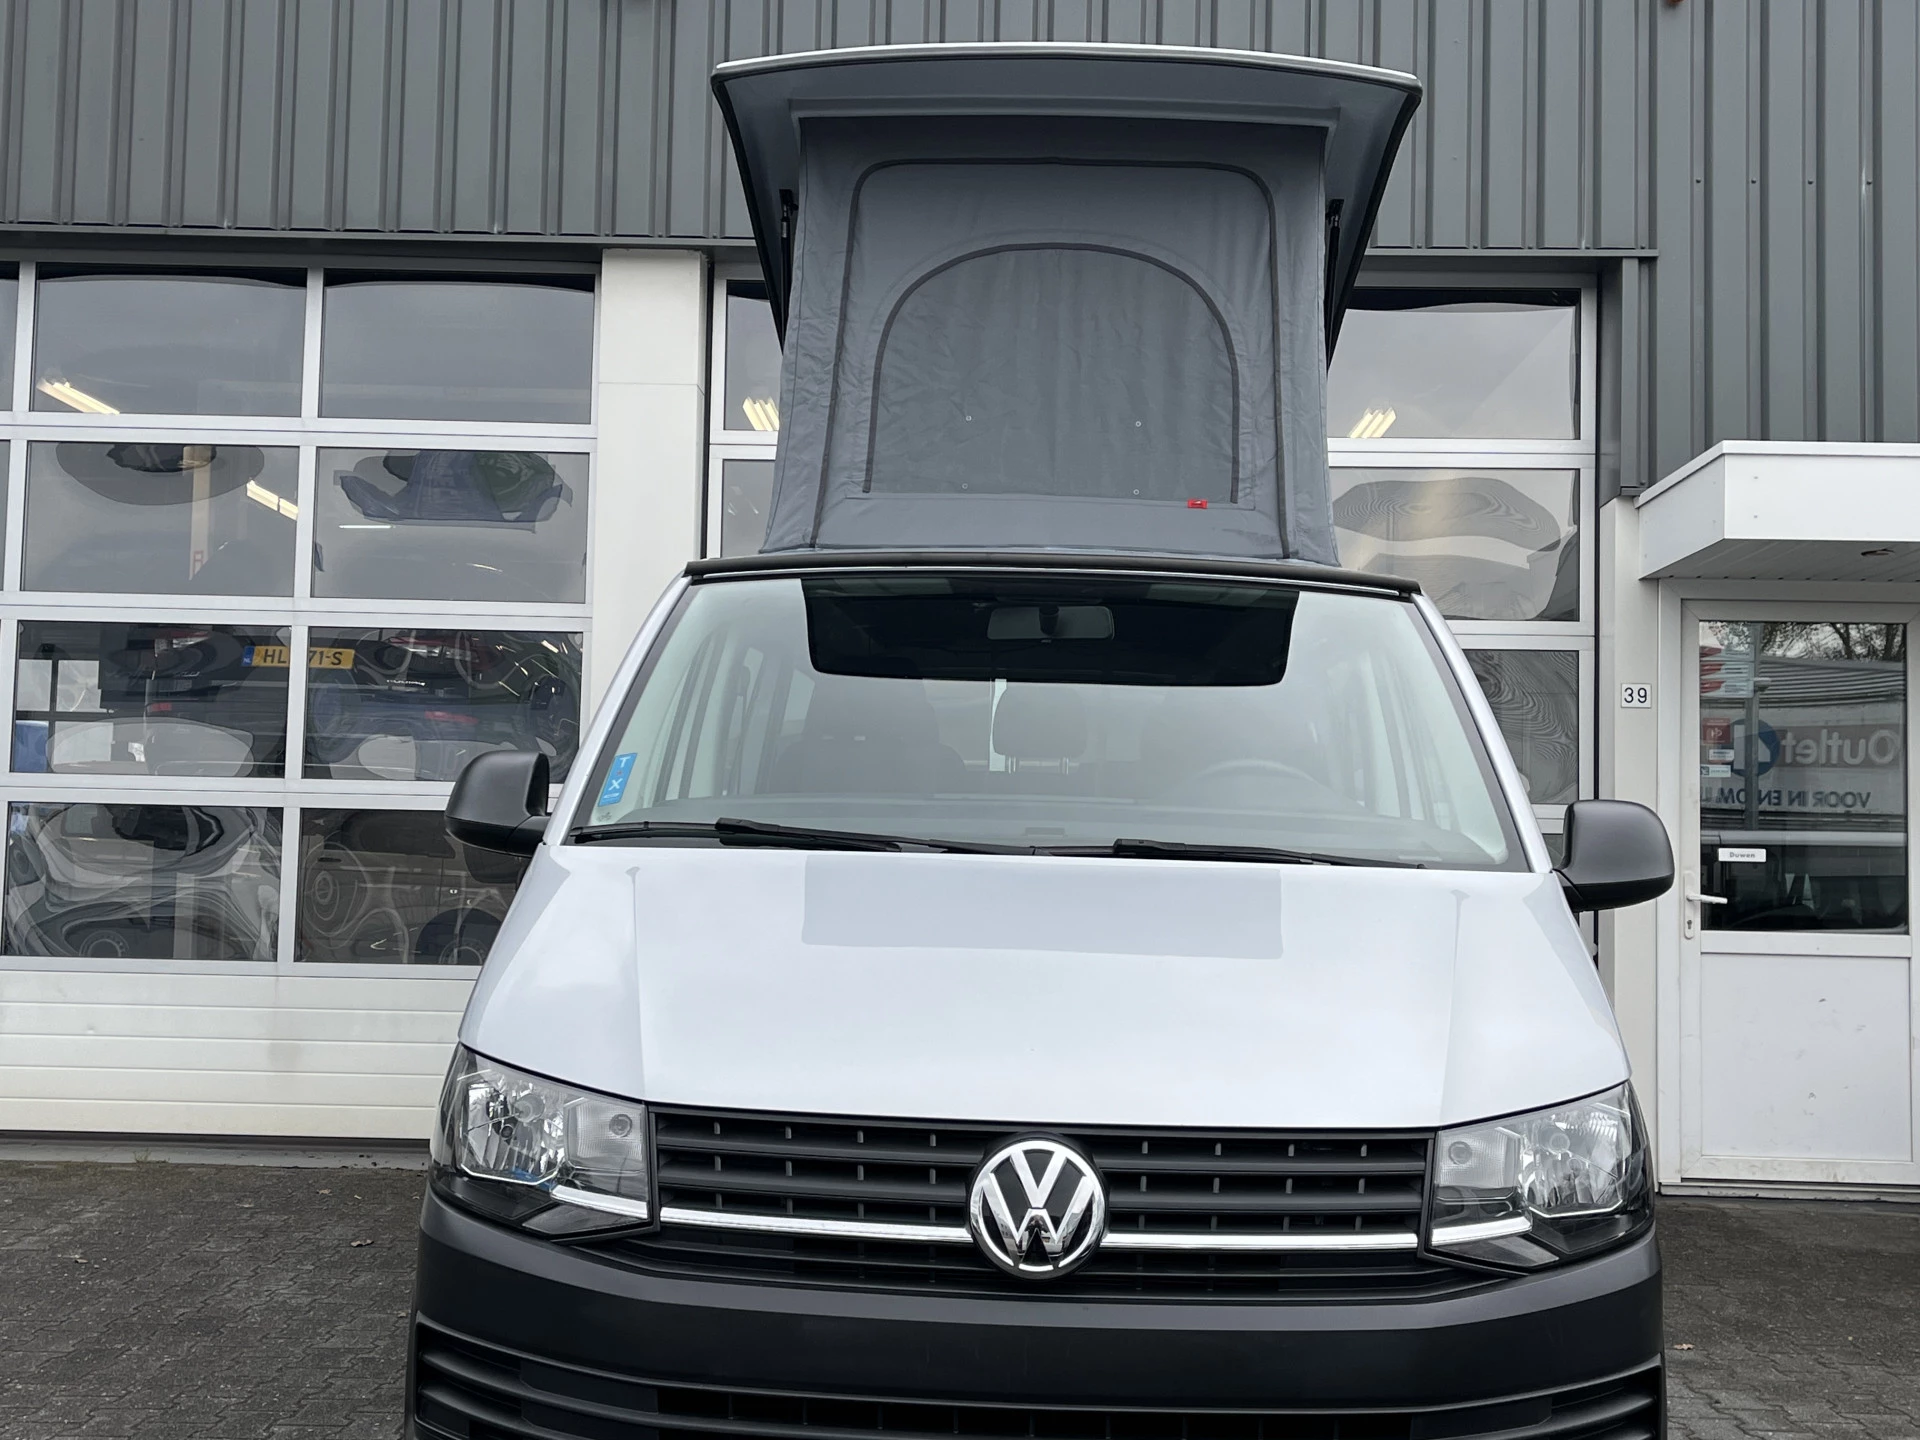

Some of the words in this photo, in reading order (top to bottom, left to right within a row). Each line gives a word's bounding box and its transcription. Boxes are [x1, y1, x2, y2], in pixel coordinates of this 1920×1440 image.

[263, 648, 343, 666] HL71-S
[1624, 686, 1648, 704] 39
[973, 1140, 1103, 1274] VW
